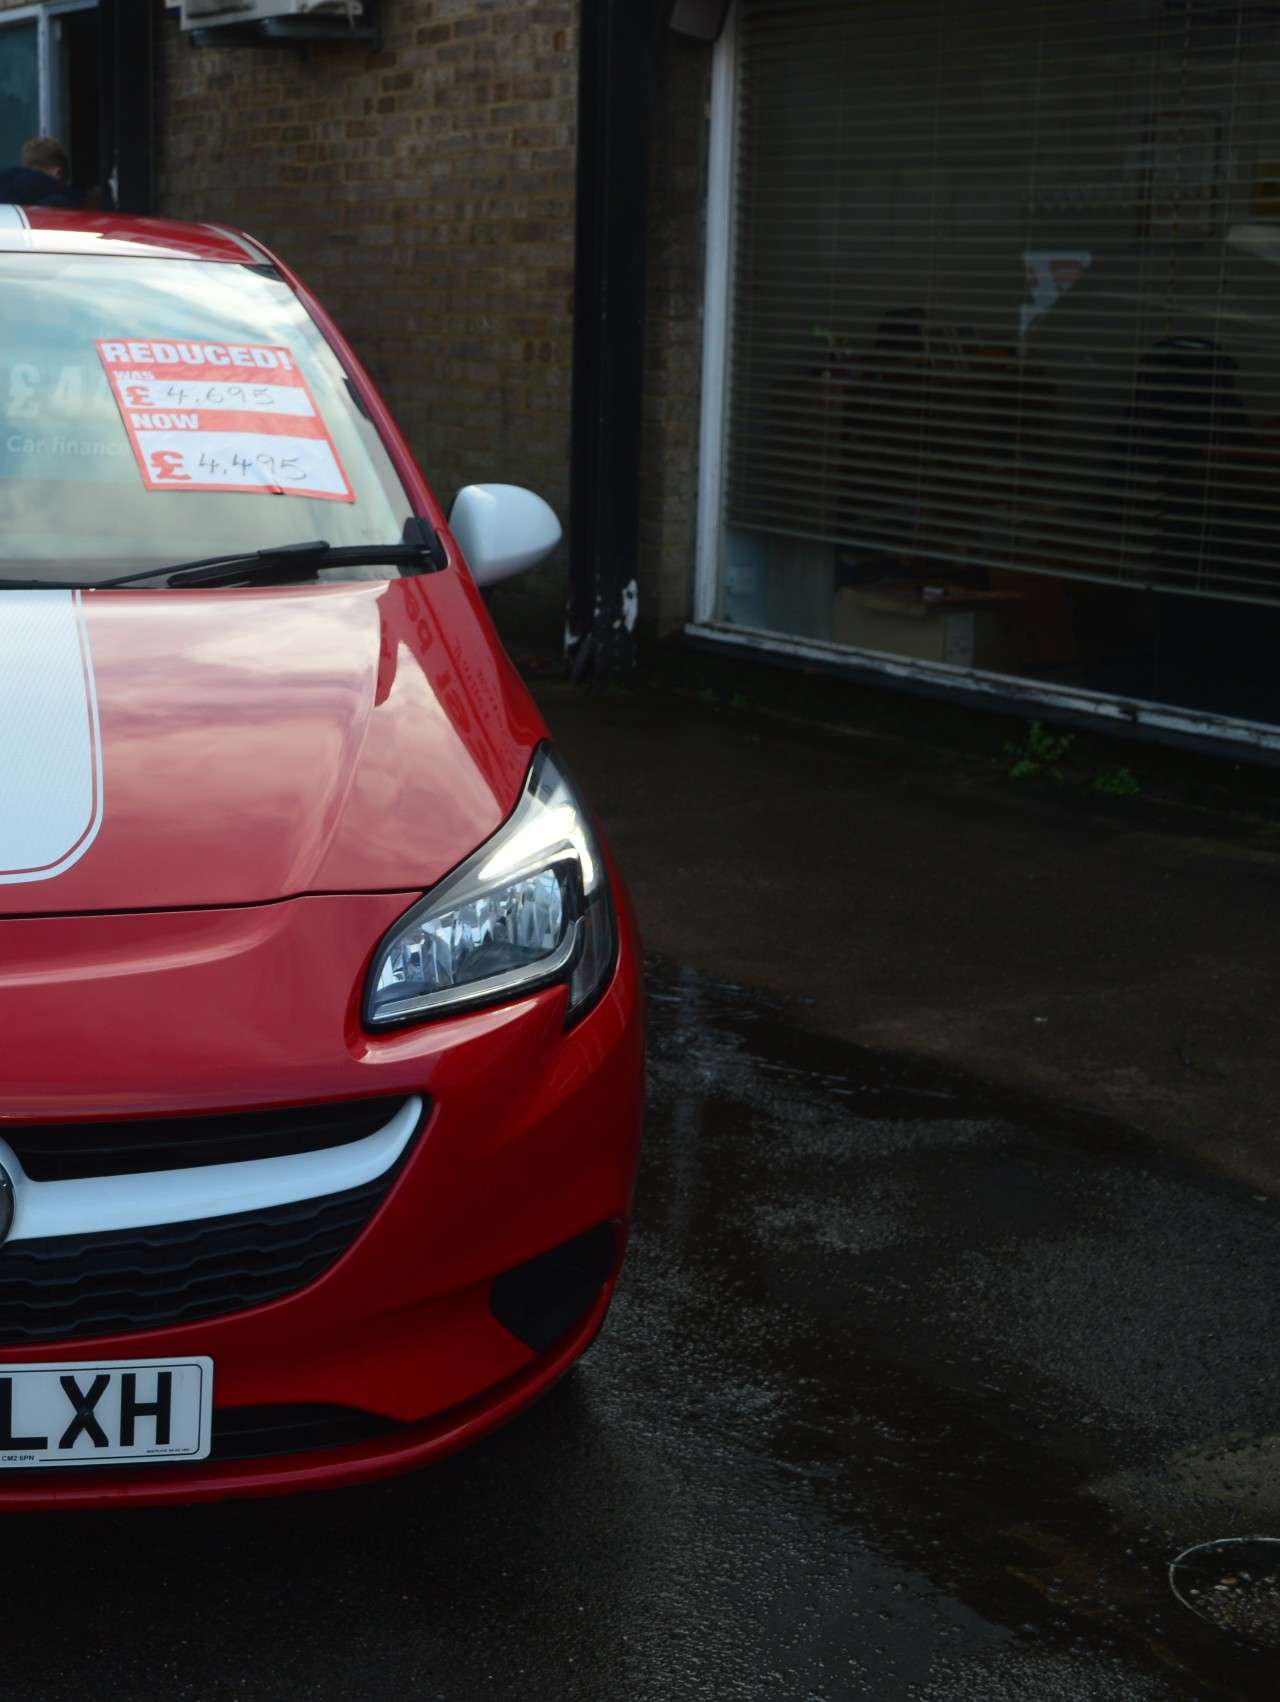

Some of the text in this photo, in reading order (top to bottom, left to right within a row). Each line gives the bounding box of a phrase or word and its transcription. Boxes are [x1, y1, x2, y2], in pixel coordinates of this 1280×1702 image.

[101, 343, 293, 370] REDUCED!
[113, 370, 155, 381] WAS
[130, 413, 199, 429] NOW
